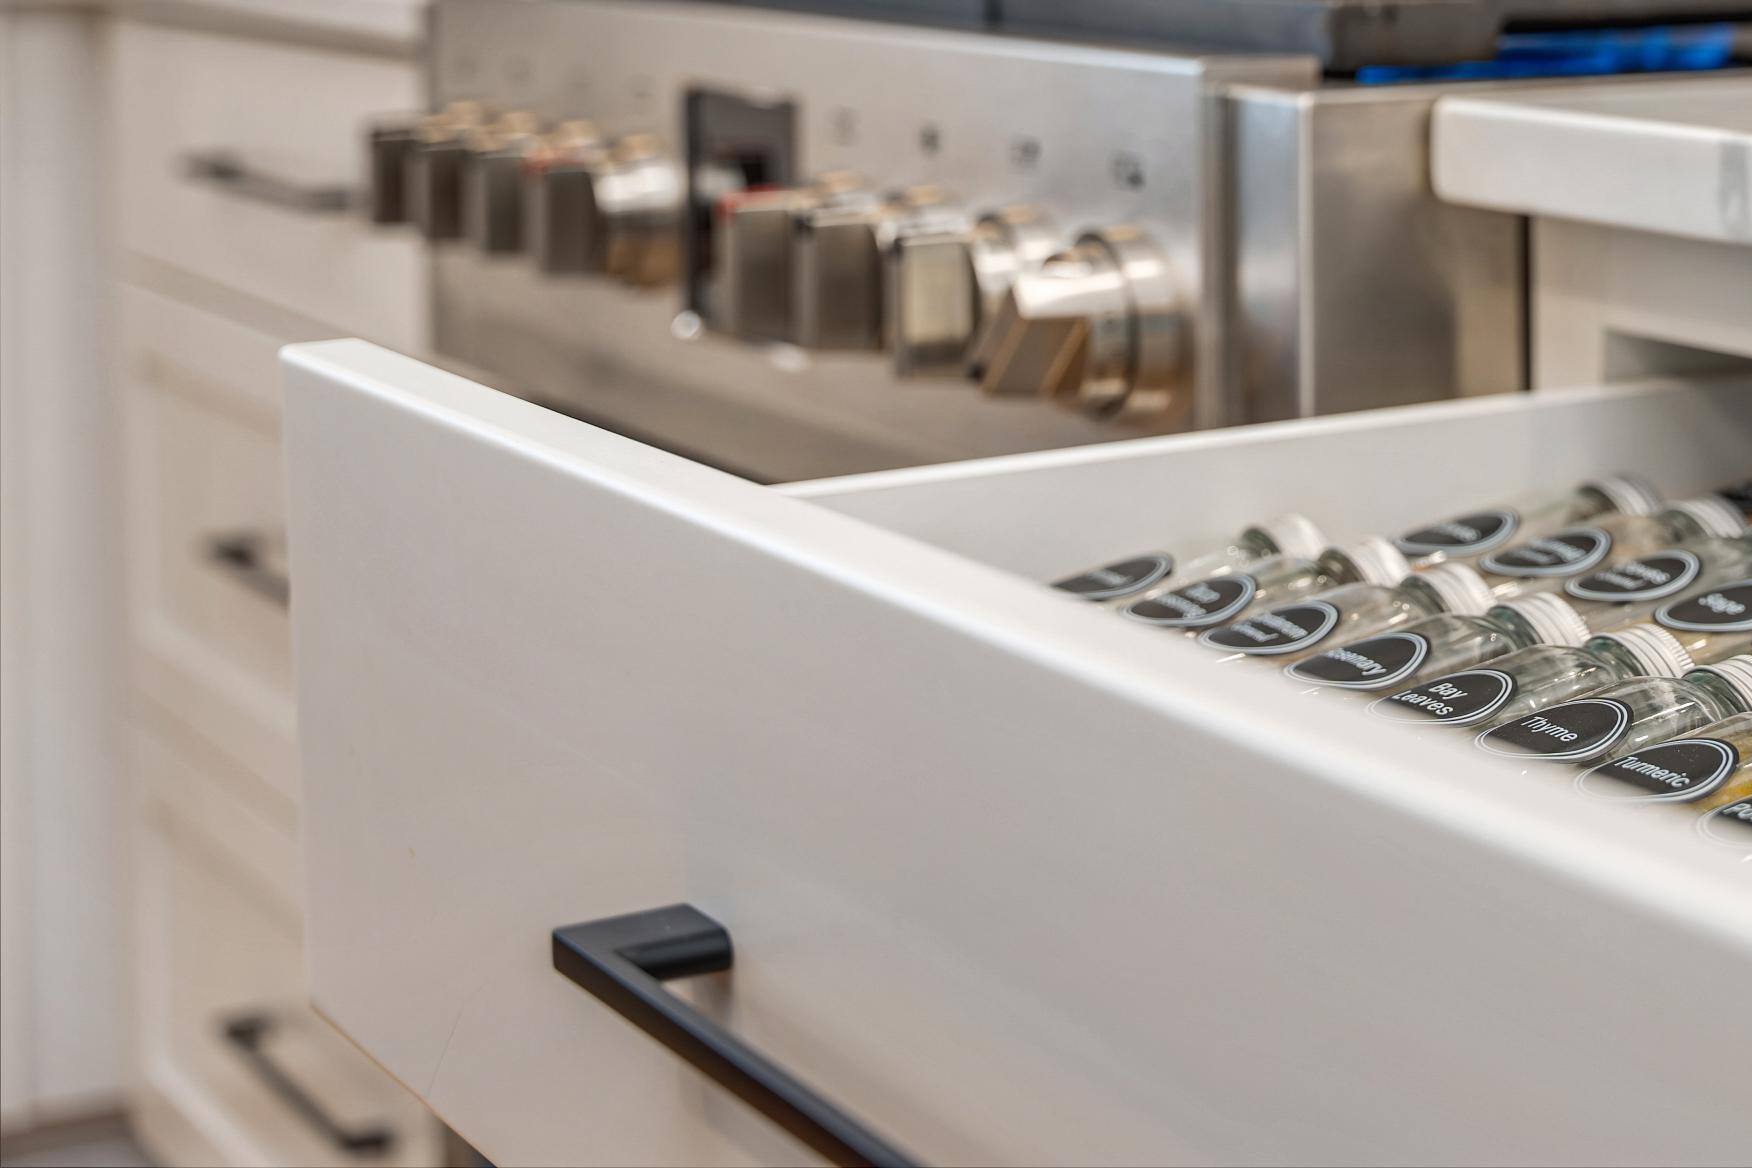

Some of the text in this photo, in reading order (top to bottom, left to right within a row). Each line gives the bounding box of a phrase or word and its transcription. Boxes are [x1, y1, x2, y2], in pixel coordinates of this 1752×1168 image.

[1391, 689, 1453, 715] Leaves
[1428, 682, 1468, 700] Bay
[1520, 716, 1579, 742] Thyme
[1614, 756, 1690, 788] Turmeric
